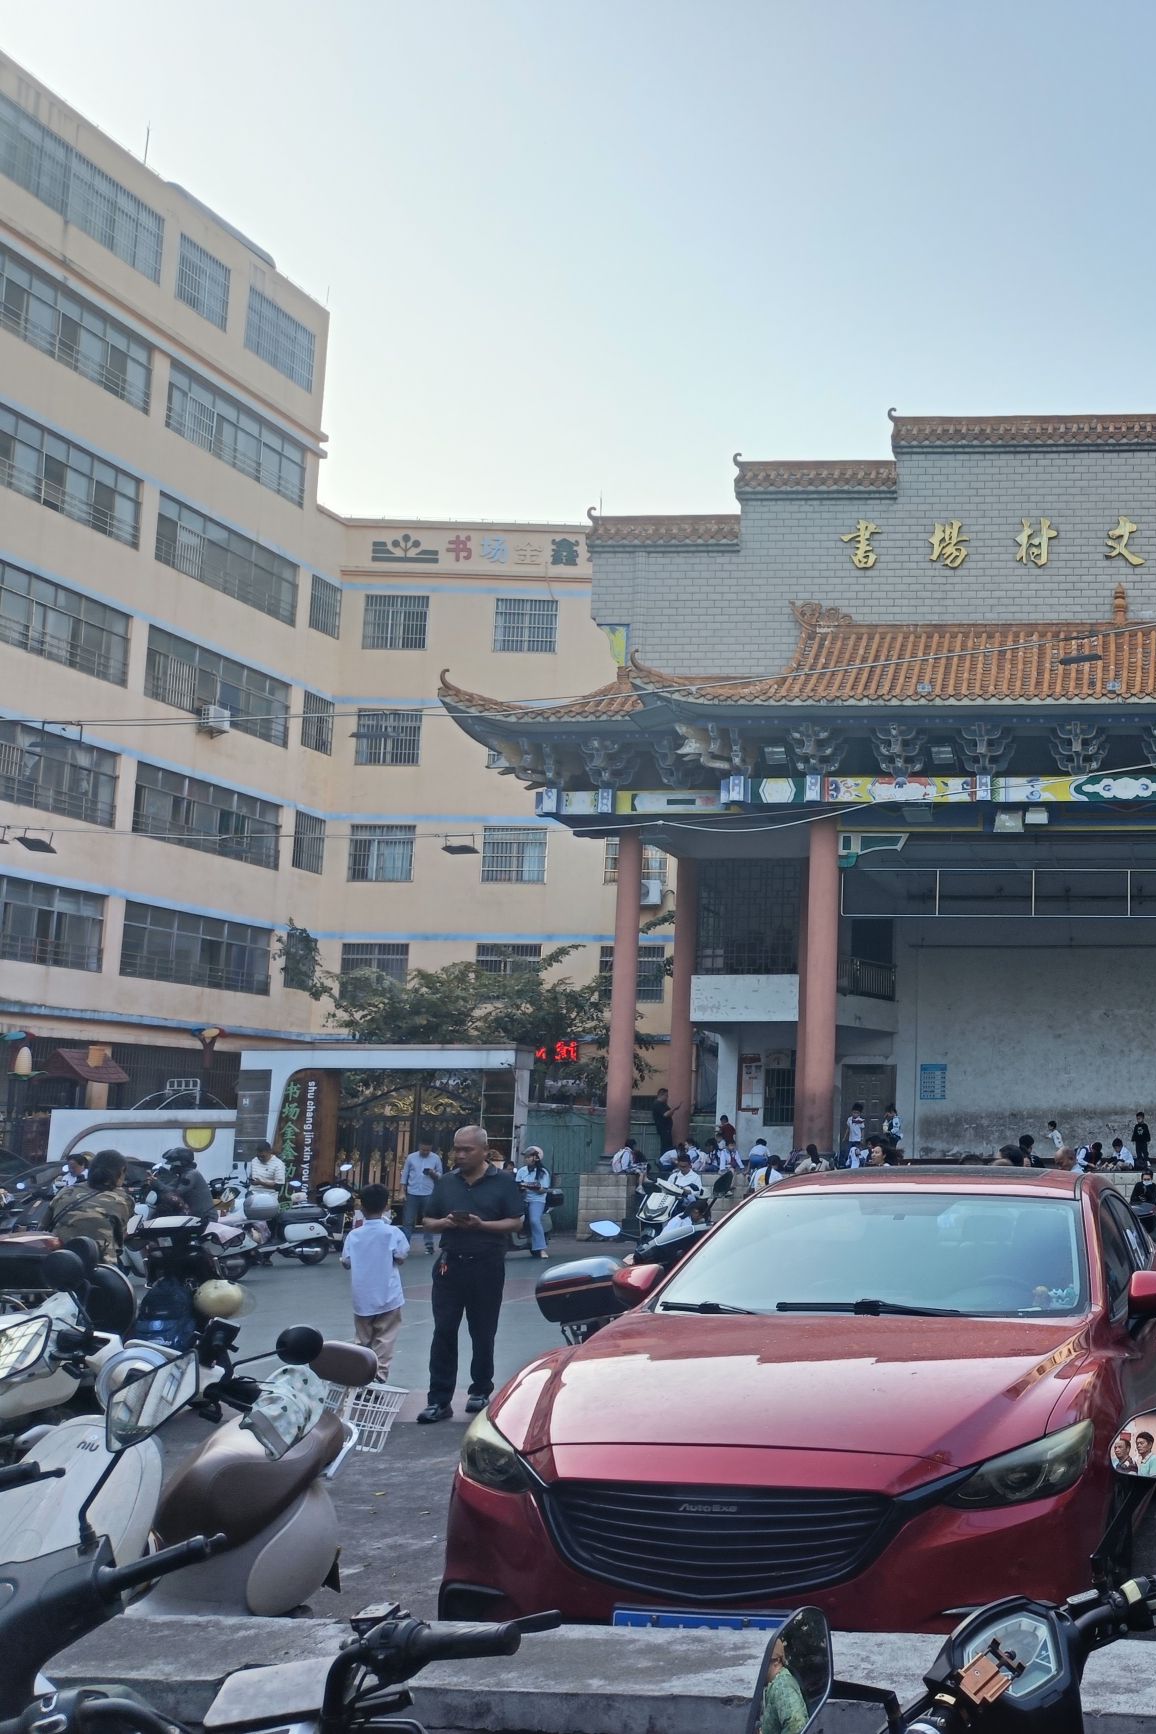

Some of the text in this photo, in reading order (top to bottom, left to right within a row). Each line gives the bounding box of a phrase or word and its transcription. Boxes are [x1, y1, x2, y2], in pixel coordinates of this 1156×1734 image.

[446, 533, 593, 567] 书场金鑫
[308, 1081, 317, 1099] shu
[304, 1100, 316, 1130] chang
[302, 1146, 314, 1161] xin
[300, 1163, 313, 1181] you
